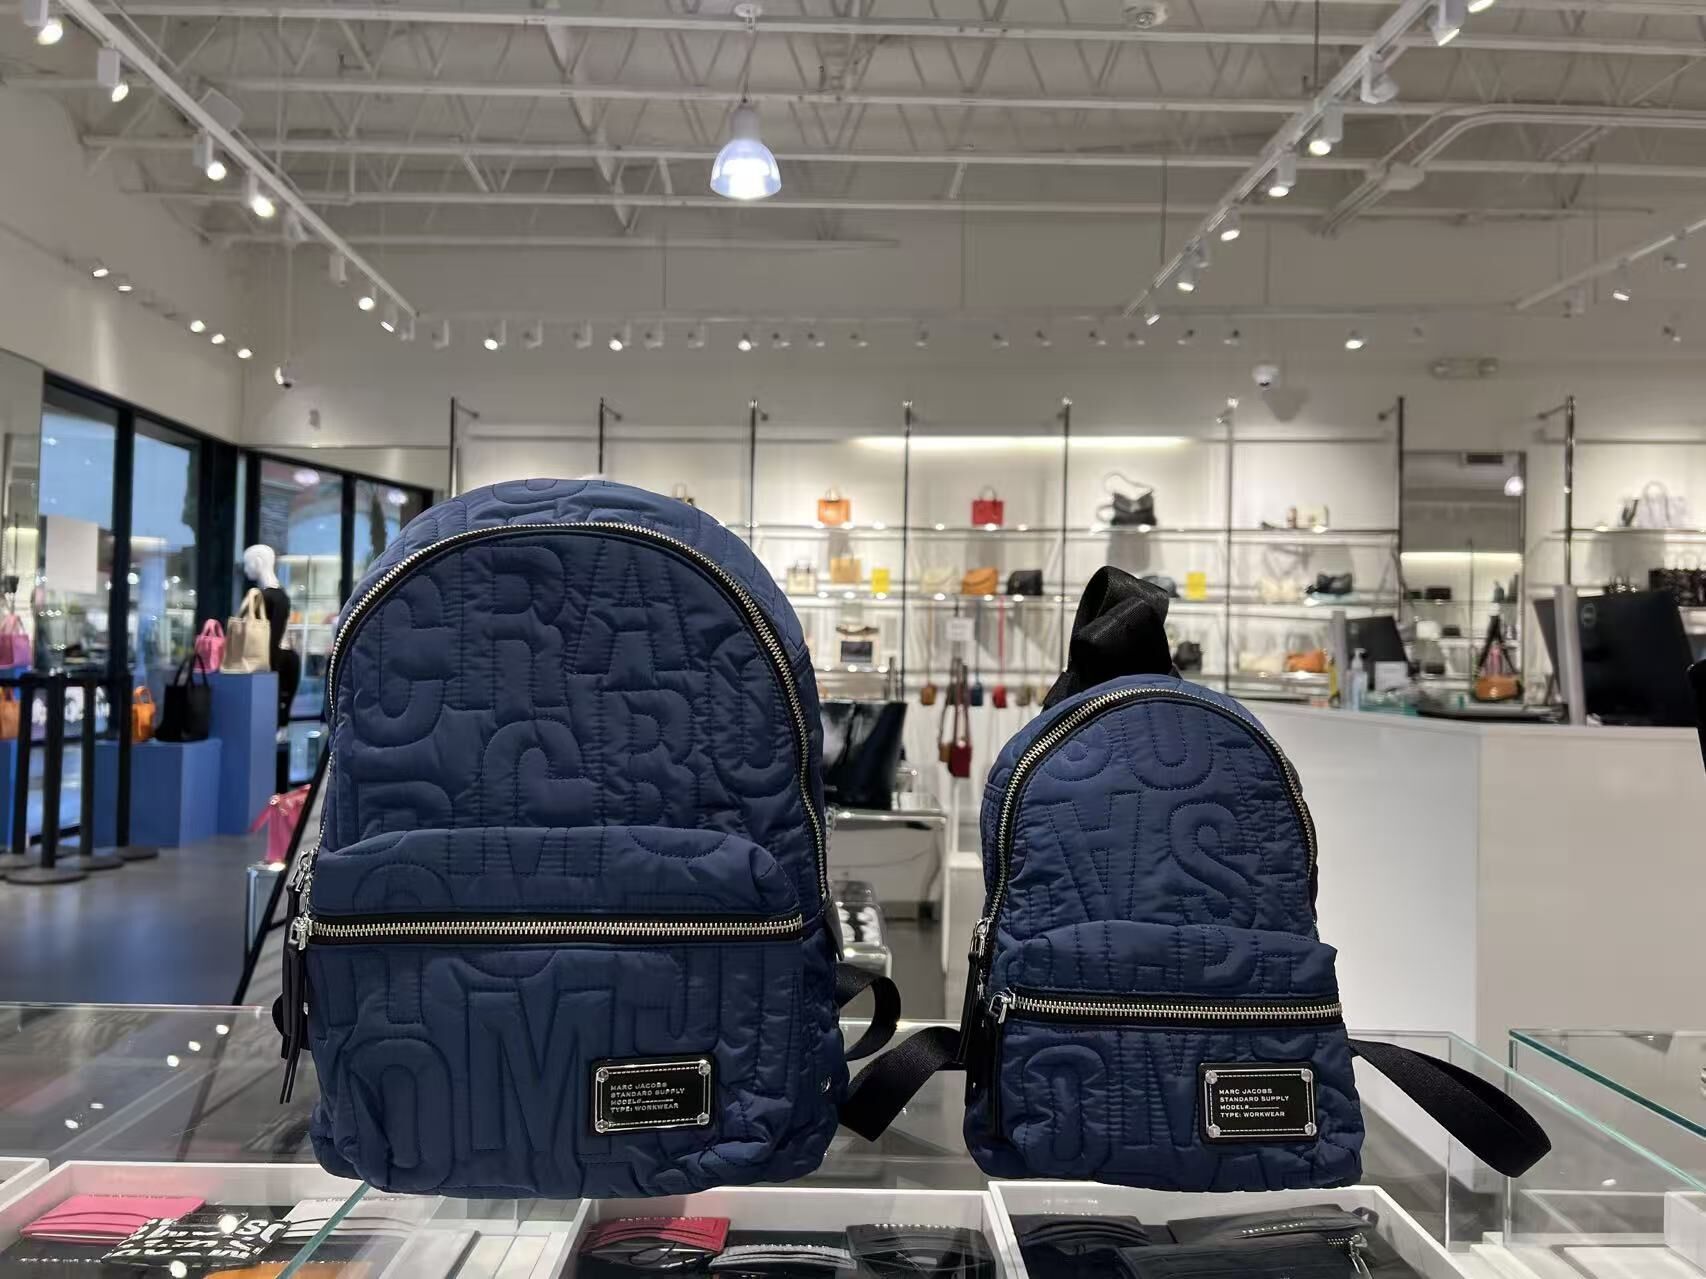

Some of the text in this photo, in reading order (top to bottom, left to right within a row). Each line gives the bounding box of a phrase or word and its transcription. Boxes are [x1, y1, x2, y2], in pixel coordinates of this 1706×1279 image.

[635, 1082, 667, 1090] JACOBS
[610, 1087, 685, 1098] STANDARD SUPPLY
[635, 1102, 679, 1111] WORKWEAR
